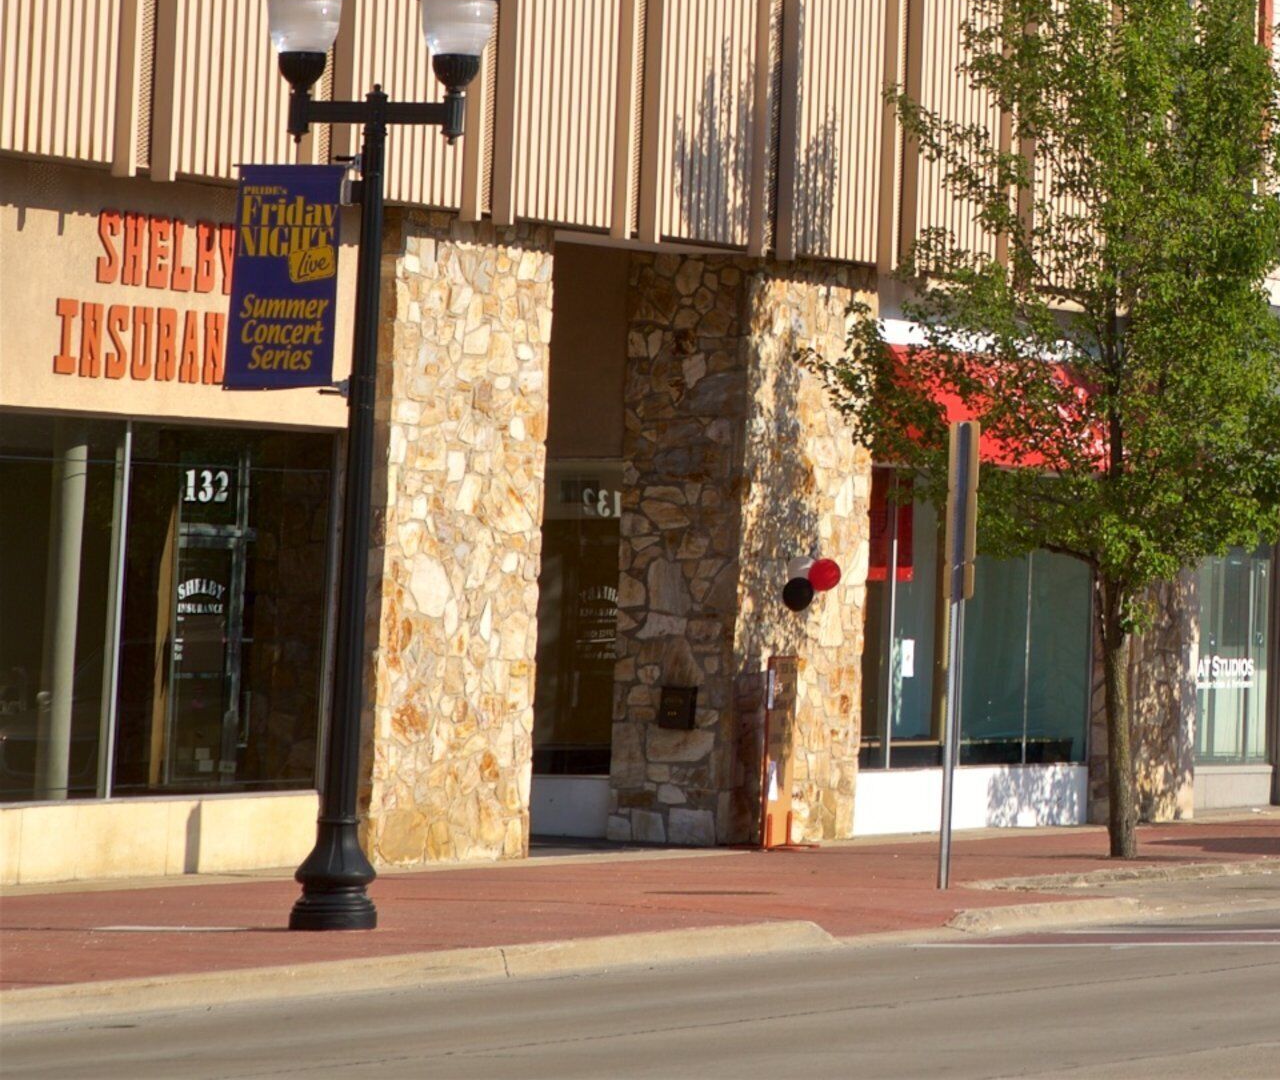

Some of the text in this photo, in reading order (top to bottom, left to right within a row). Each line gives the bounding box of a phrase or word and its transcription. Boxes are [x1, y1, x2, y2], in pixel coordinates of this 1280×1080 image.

[241, 195, 339, 226] Friday
[96, 207, 236, 295] SHELBY
[239, 226, 335, 257] NIGHT
[297, 251, 331, 278] Live
[240, 294, 329, 319] Summer
[53, 297, 226, 385] INSURAN
[241, 320, 324, 344] Concert
[247, 344, 313, 370] Series
[184, 469, 229, 502] 132
[178, 578, 226, 600] SHELBY
[177, 603, 223, 613] INSURANCE
[1212, 656, 1255, 677] STUDIOS
